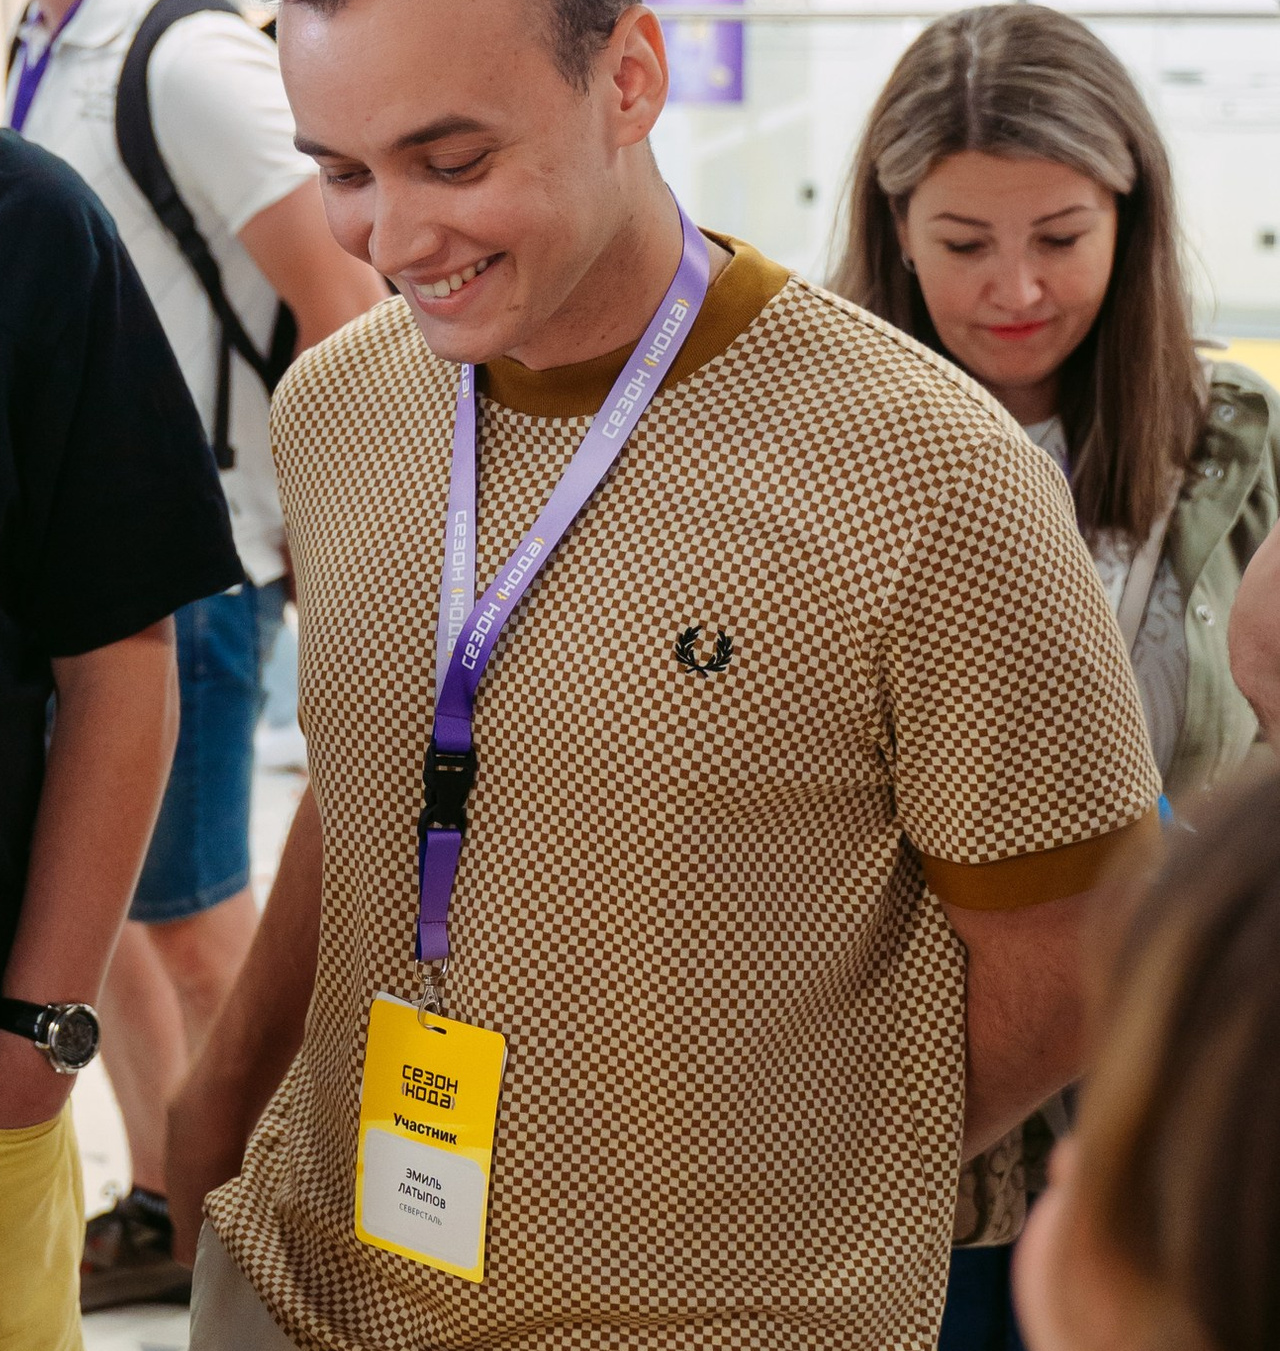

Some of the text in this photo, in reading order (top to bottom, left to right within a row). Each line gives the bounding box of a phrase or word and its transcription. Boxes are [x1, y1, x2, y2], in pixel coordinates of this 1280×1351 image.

[394, 1113, 457, 1145] Участник
[405, 1167, 442, 1191] ЭМИЛЬ
[398, 1183, 447, 1209] ЛАТЫПОВ
[398, 1203, 443, 1226] СЕВЕРСТАЛЬ
